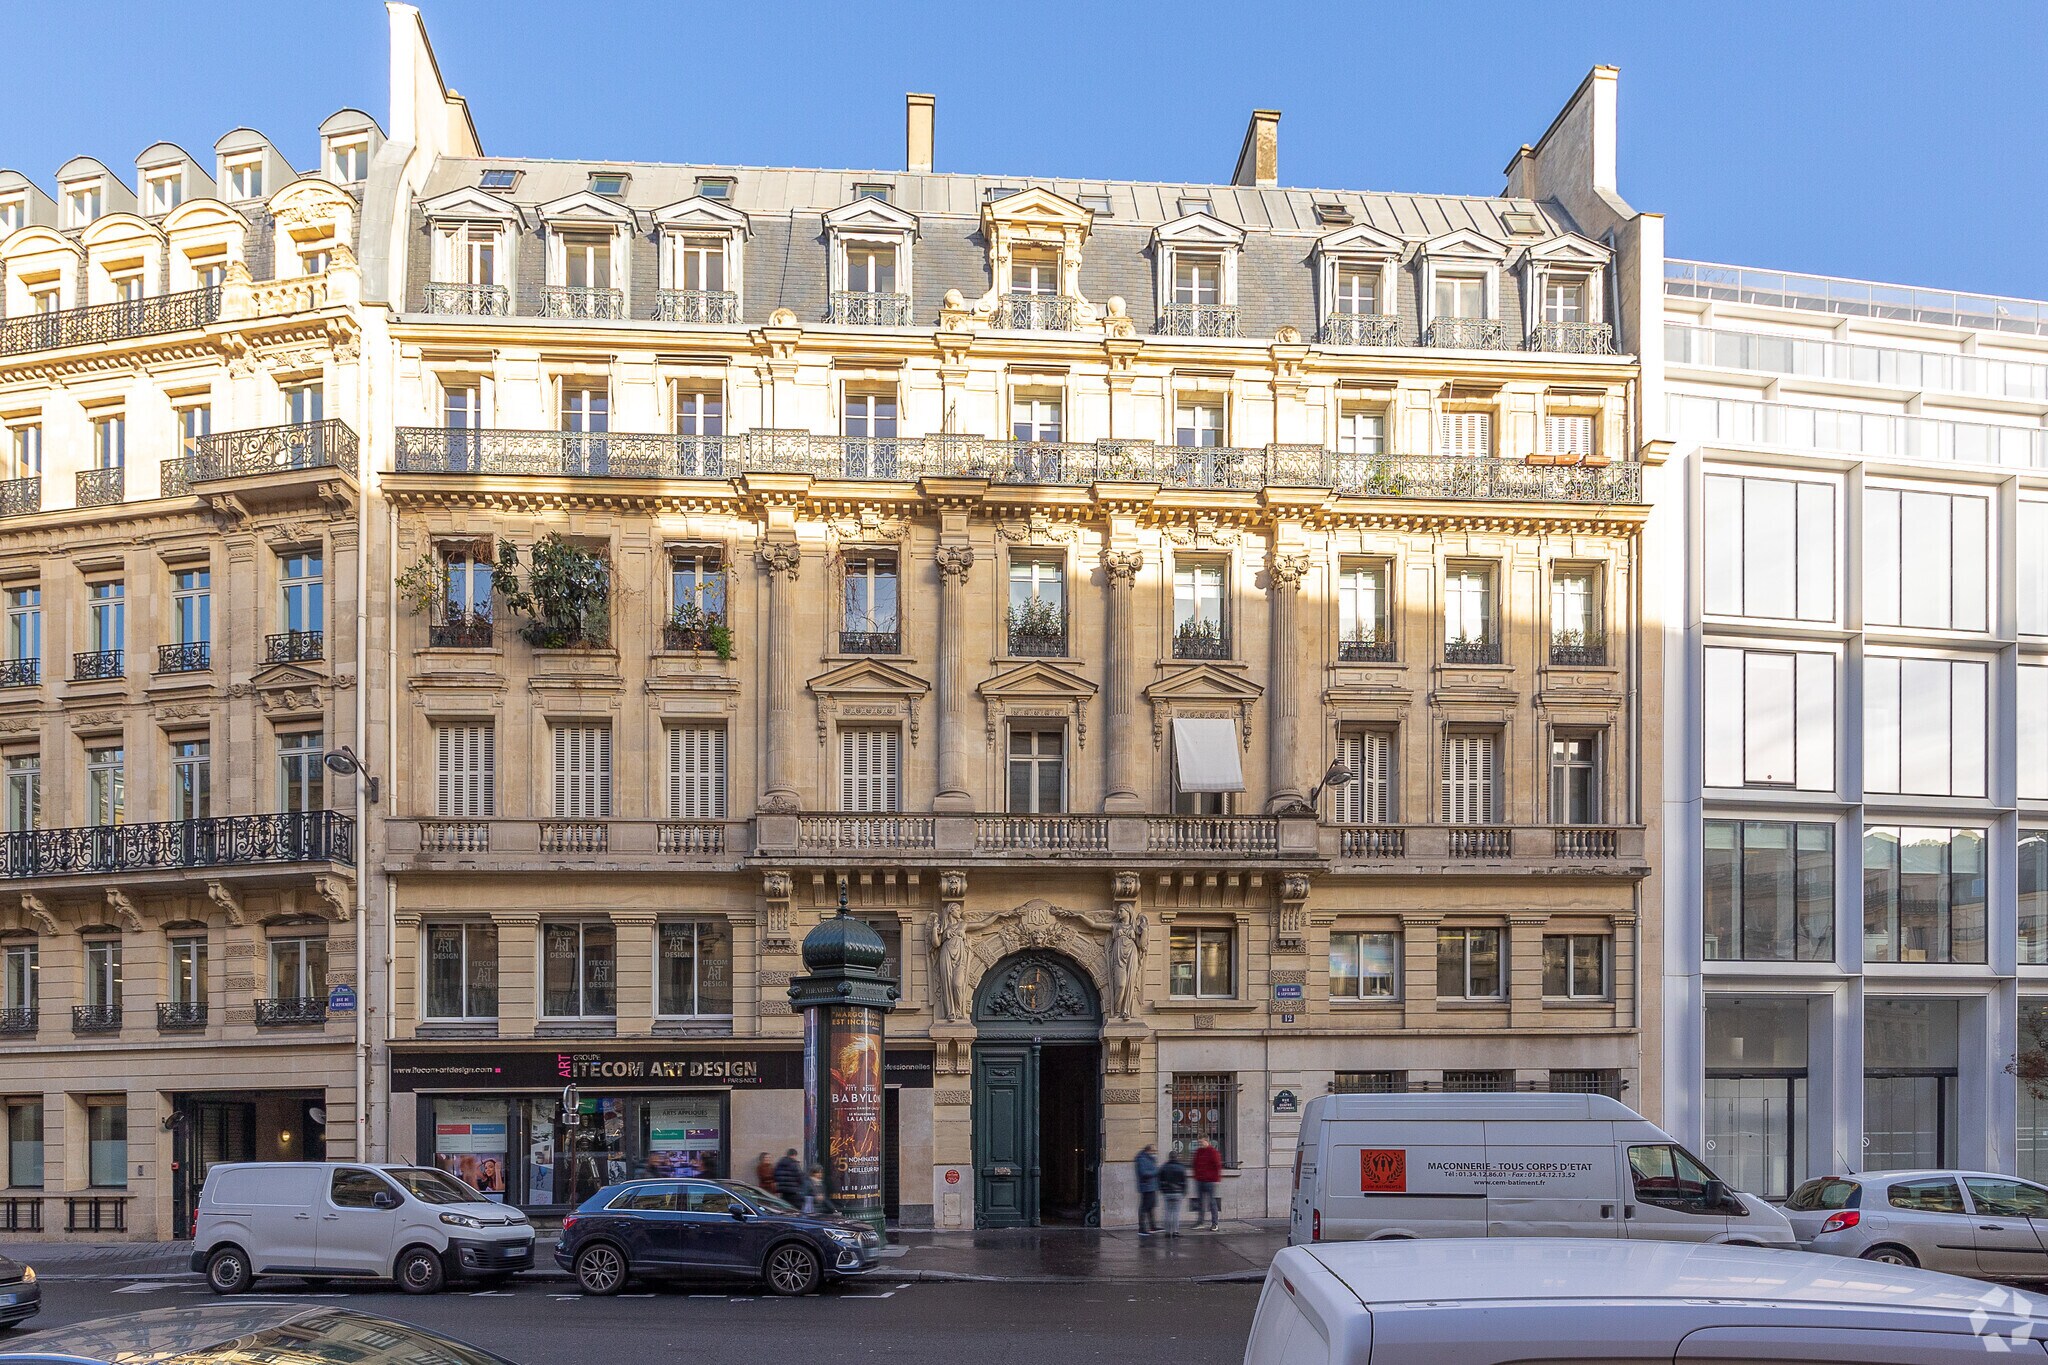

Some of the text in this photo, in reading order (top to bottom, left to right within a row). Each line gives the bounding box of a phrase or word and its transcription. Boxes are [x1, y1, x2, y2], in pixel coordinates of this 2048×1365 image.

[437, 938, 455, 952] ART
[554, 937, 571, 951] ART
[669, 937, 686, 951] ART
[477, 967, 494, 981] ART
[593, 967, 609, 981] ART
[707, 966, 724, 980] ART
[558, 1054, 571, 1078] ART
[572, 1061, 757, 1078] ITECOM ART DESIGN
[837, 1157, 849, 1172] 5
[1427, 1162, 1491, 1171] MAÇONNERIE
[1498, 1162, 1525, 1171] TOUS
[1526, 1163, 1558, 1171] CORPS
